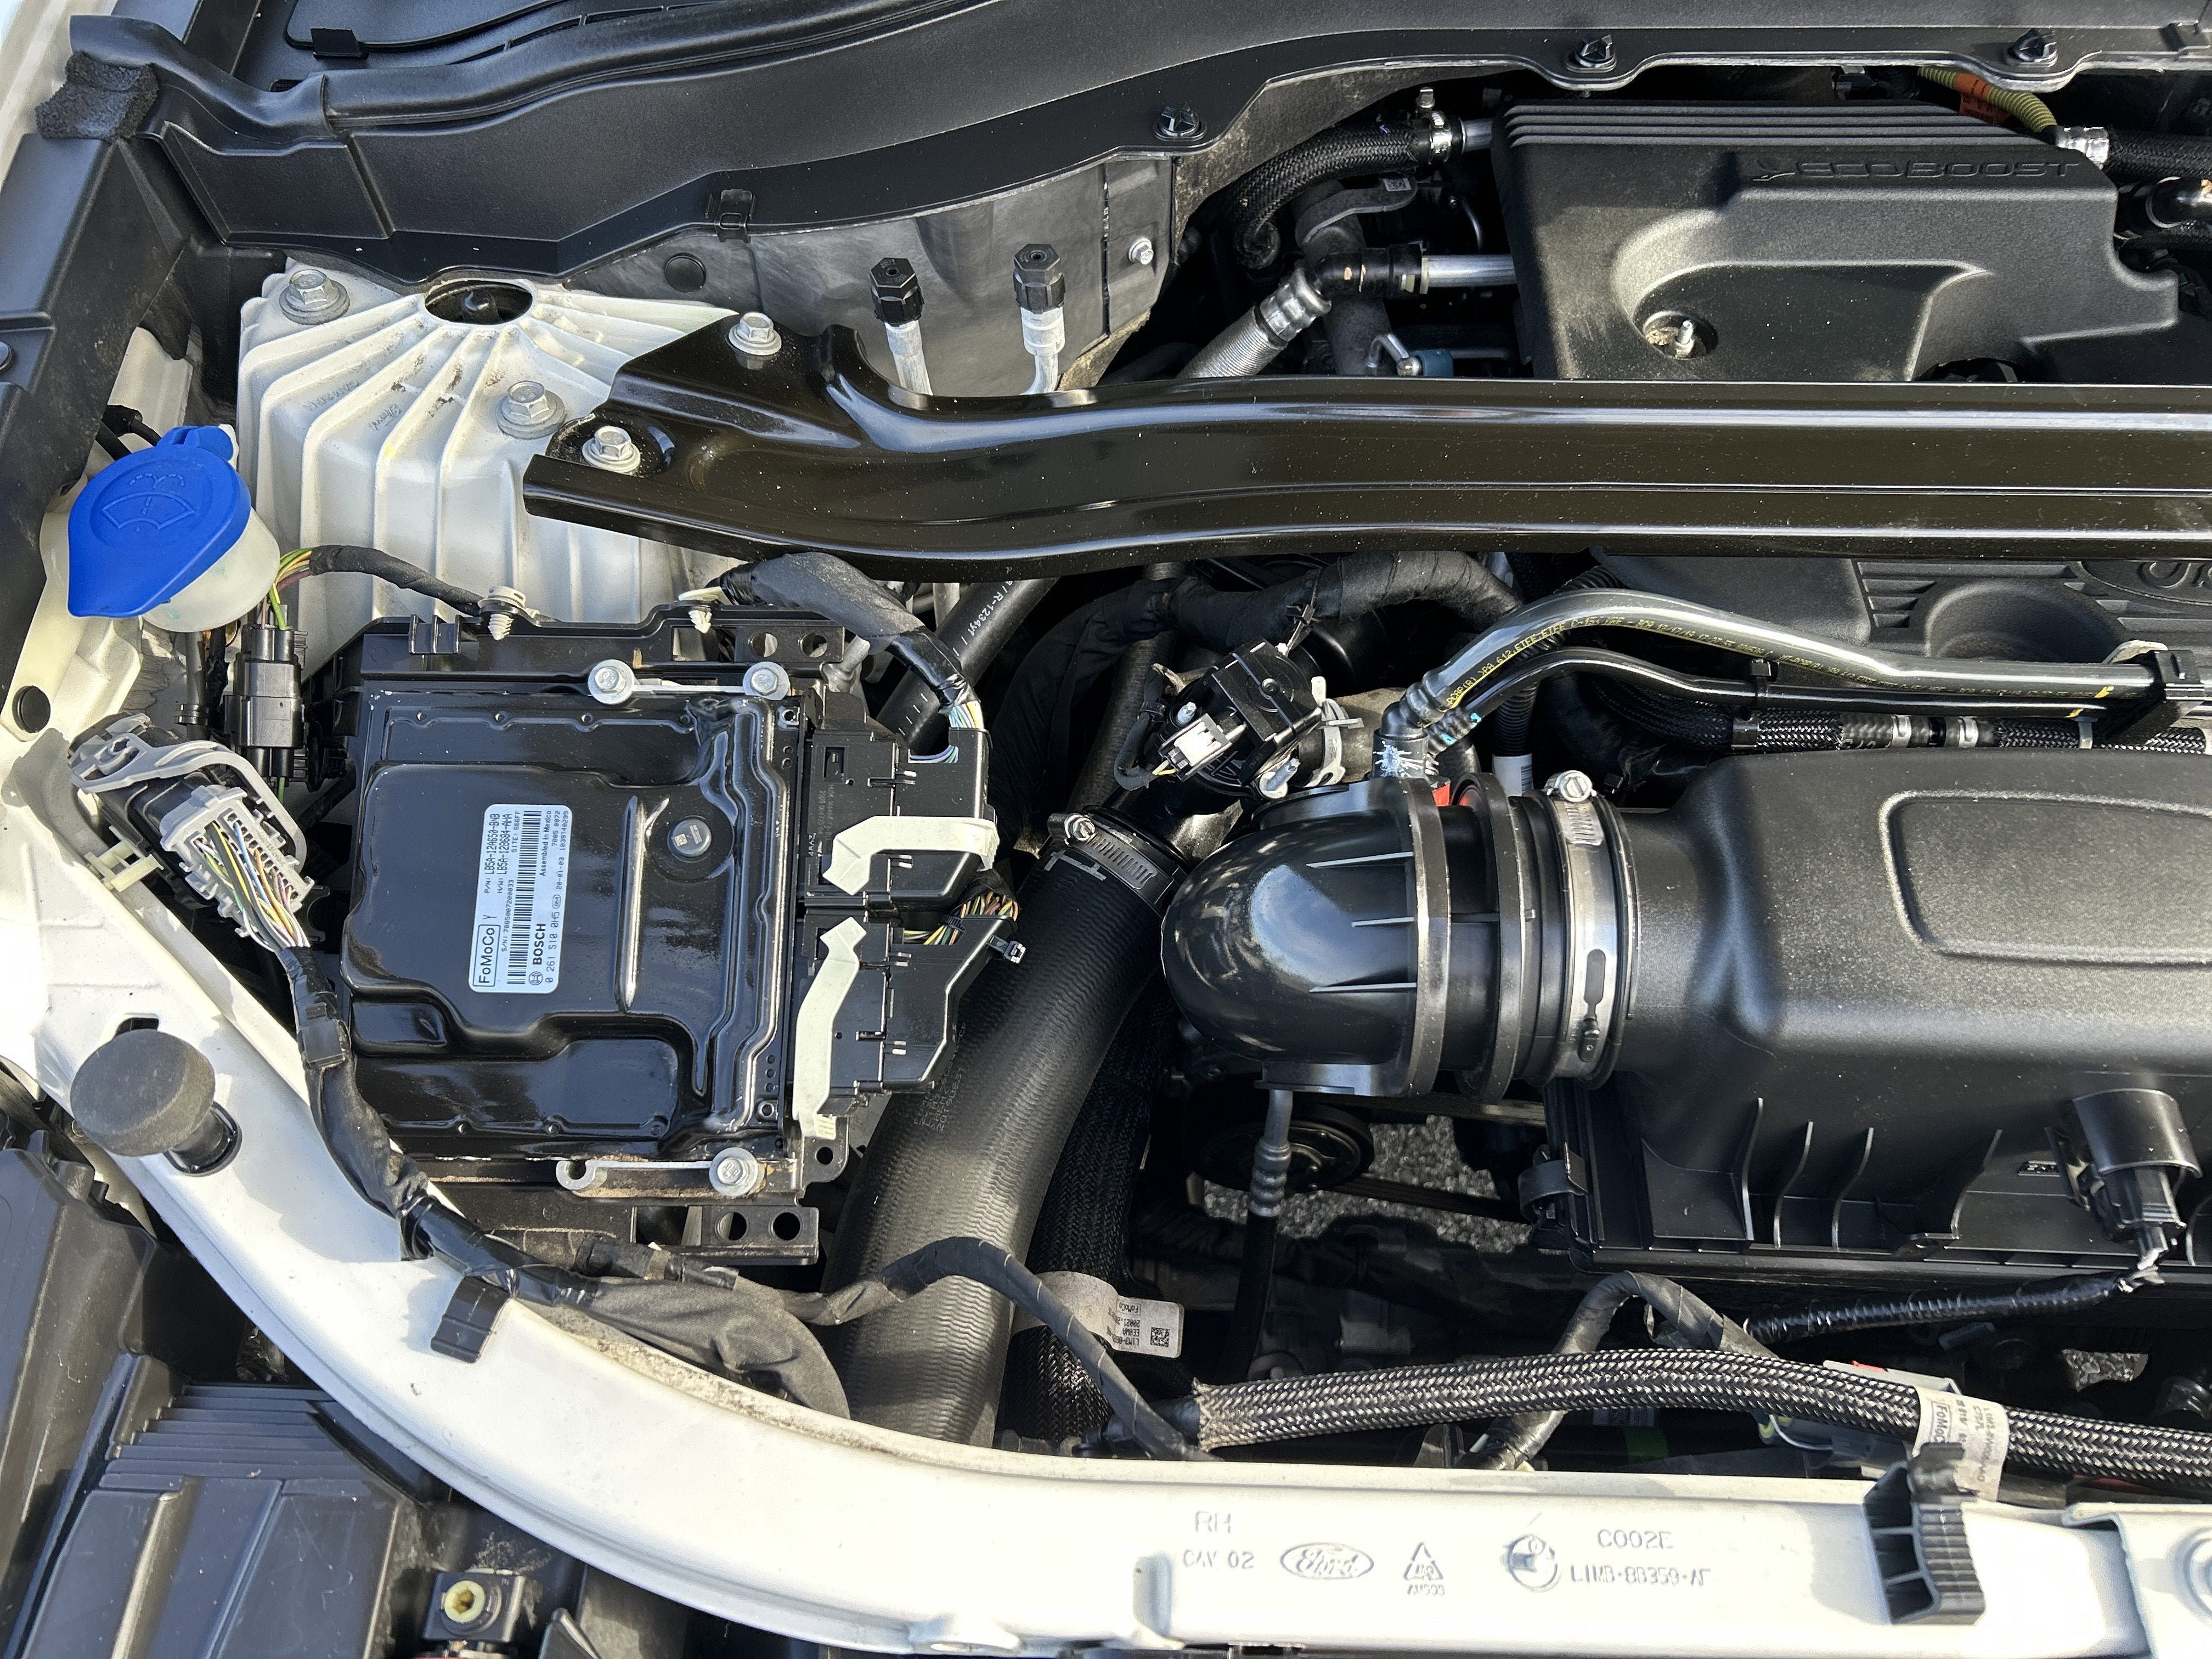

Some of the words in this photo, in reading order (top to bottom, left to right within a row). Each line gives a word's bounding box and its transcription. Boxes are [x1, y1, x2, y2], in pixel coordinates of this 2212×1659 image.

[485, 813, 500, 875] LB5A-12A650-BNB
[546, 956, 555, 973] 261
[556, 857, 565, 890] 20-01-03
[479, 927, 495, 984] FoMoCo
[532, 923, 546, 965] BOSCH
[1119, 1302, 1139, 1314] FoMoCo
[1194, 1510, 1232, 1534] RH
[1227, 1548, 1255, 1570] 02
